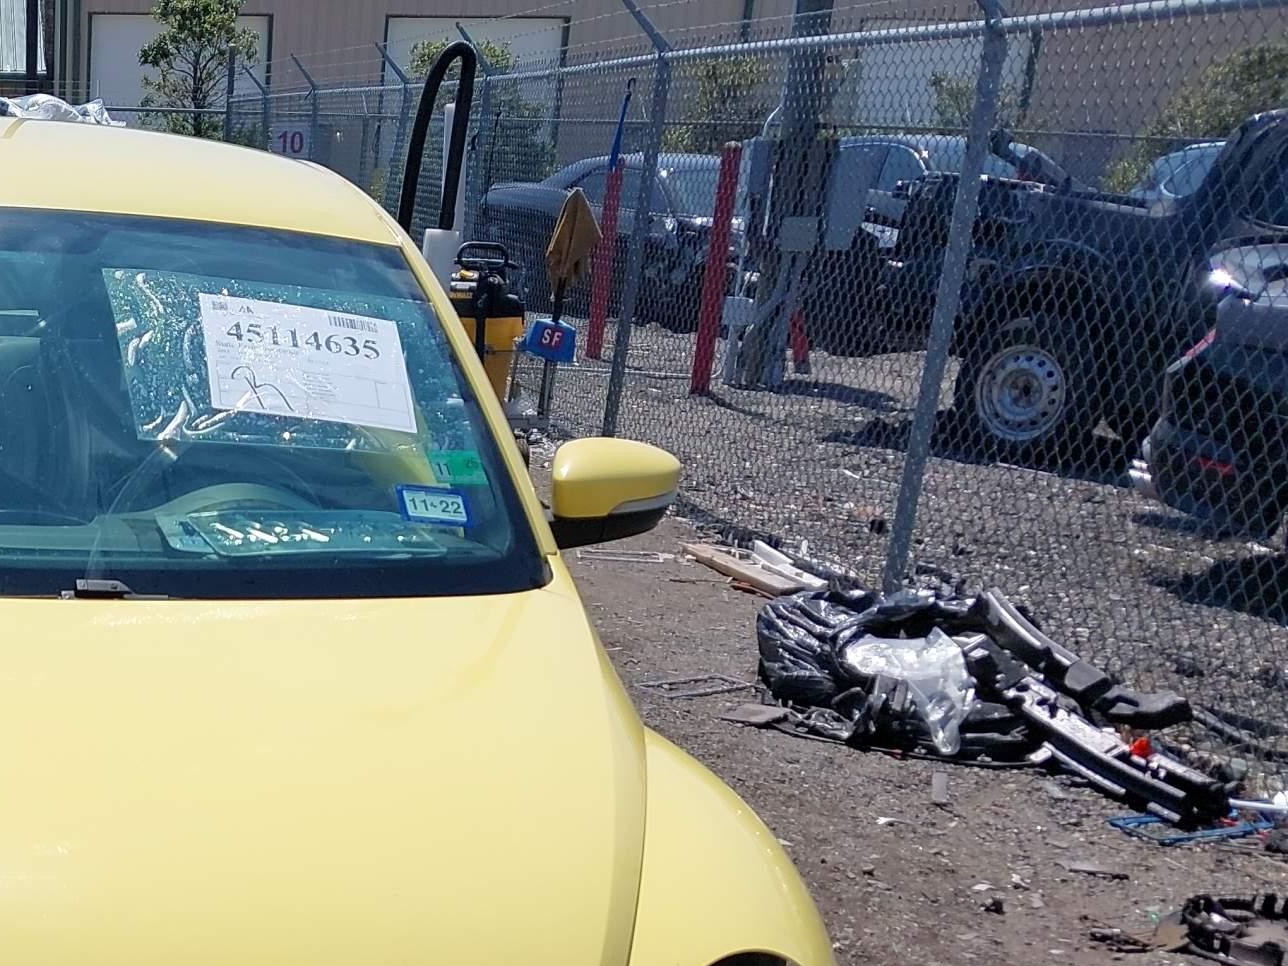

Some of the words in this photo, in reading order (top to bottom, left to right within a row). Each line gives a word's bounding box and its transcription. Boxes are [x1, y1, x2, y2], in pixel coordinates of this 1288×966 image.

[278, 130, 304, 153] 10
[226, 321, 380, 360] 45114635
[542, 328, 563, 346] SF
